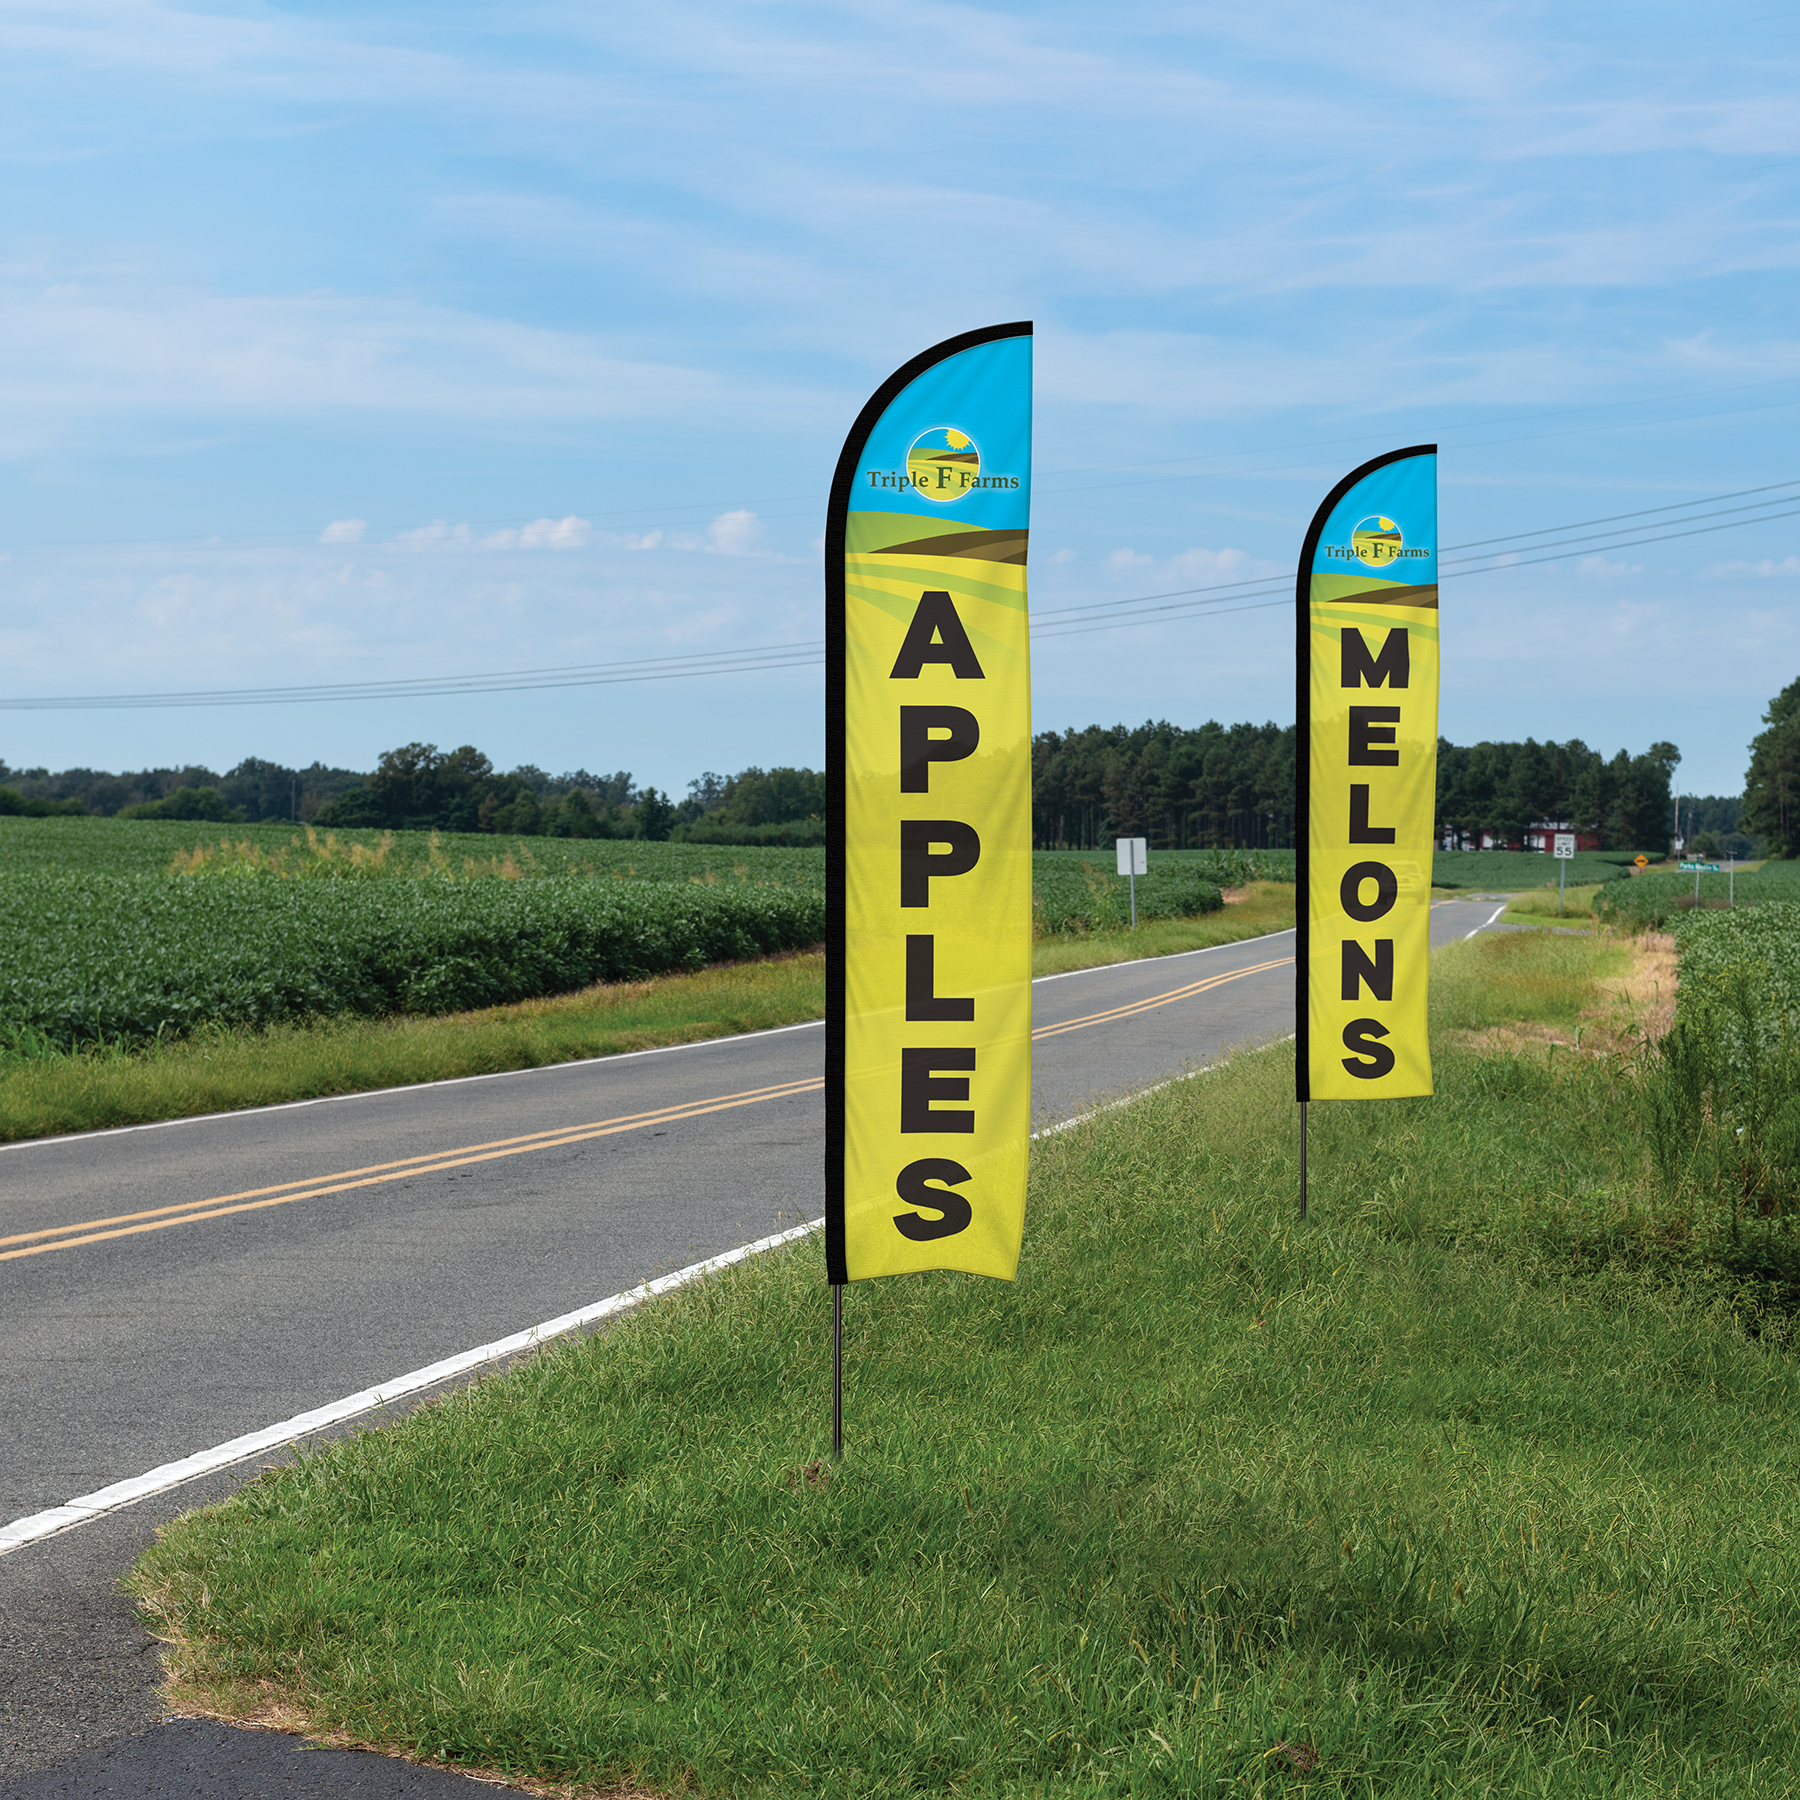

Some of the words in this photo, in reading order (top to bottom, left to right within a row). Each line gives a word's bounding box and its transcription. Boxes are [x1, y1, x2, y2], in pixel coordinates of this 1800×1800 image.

[866, 471, 929, 492] Triple
[936, 467, 953, 489] F
[959, 472, 1020, 489] Farms
[1324, 546, 1368, 561] Triple
[1372, 542, 1384, 558] F
[1388, 546, 1430, 558] Farms
[1340, 628, 1409, 1079] MELONS
[1556, 846, 1572, 857] 55
[890, 591, 985, 1241] APPLES
